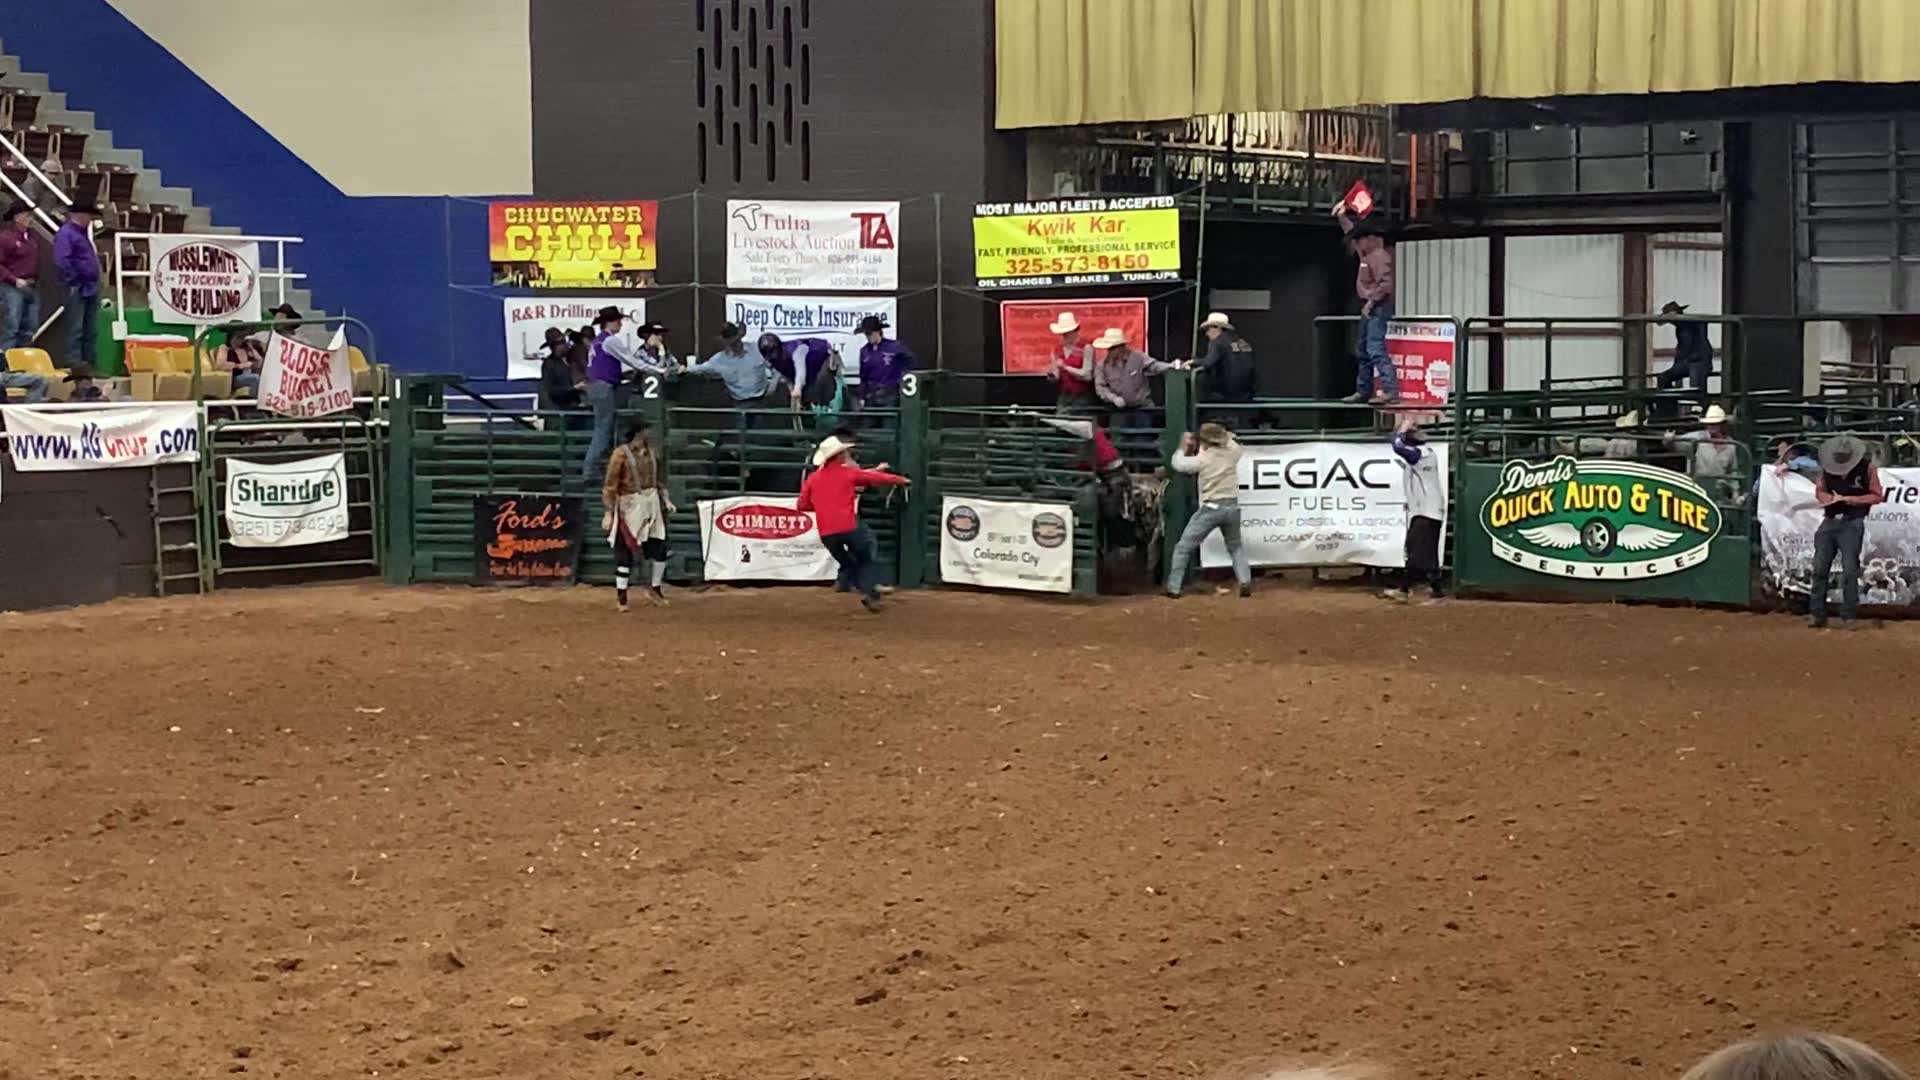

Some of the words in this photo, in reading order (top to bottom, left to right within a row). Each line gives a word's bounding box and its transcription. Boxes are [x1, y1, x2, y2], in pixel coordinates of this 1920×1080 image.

[505, 206, 642, 223] CHUGWATER
[976, 203, 1010, 215] MOST
[1013, 202, 1057, 213] MAJOR
[1060, 200, 1106, 211] FLEETS
[1110, 196, 1174, 209] ACCEPTED
[1027, 218, 1077, 236] Kwik
[1090, 216, 1126, 233] Kar
[505, 224, 644, 261] CHILI
[733, 232, 798, 249] Livestock
[806, 232, 856, 250] Auction
[1057, 242, 1131, 254] PROFESSIONAL
[1134, 239, 1176, 250] SERVICE
[1006, 253, 1150, 275] 325-573-8150
[178, 274, 231, 287] TRUCKING
[978, 279, 997, 288] OIL
[1000, 277, 1053, 287] CHANGES
[1064, 275, 1110, 285] BRAKES
[1121, 271, 1179, 282] TUNE-UPS
[191, 288, 240, 315] BUILDING
[512, 304, 546, 323] R&R
[735, 303, 769, 331] Deep
[773, 303, 814, 328] Creek
[643, 376, 659, 399] 2
[902, 374, 917, 396] 3
[1239, 457, 1405, 490] EGAC
[1503, 461, 1574, 495] Dennis
[1288, 496, 1367, 511] FUELS
[1630, 483, 1650, 512] &
[492, 500, 567, 534] Ford's
[721, 513, 808, 530] GRIMMETT
[1296, 516, 1337, 527] DIESEL
[1263, 532, 1308, 543] LOCALLY
[973, 546, 1018, 563] Colorado
[1021, 551, 1040, 568] City
[1512, 552, 1685, 577] SERVICE
